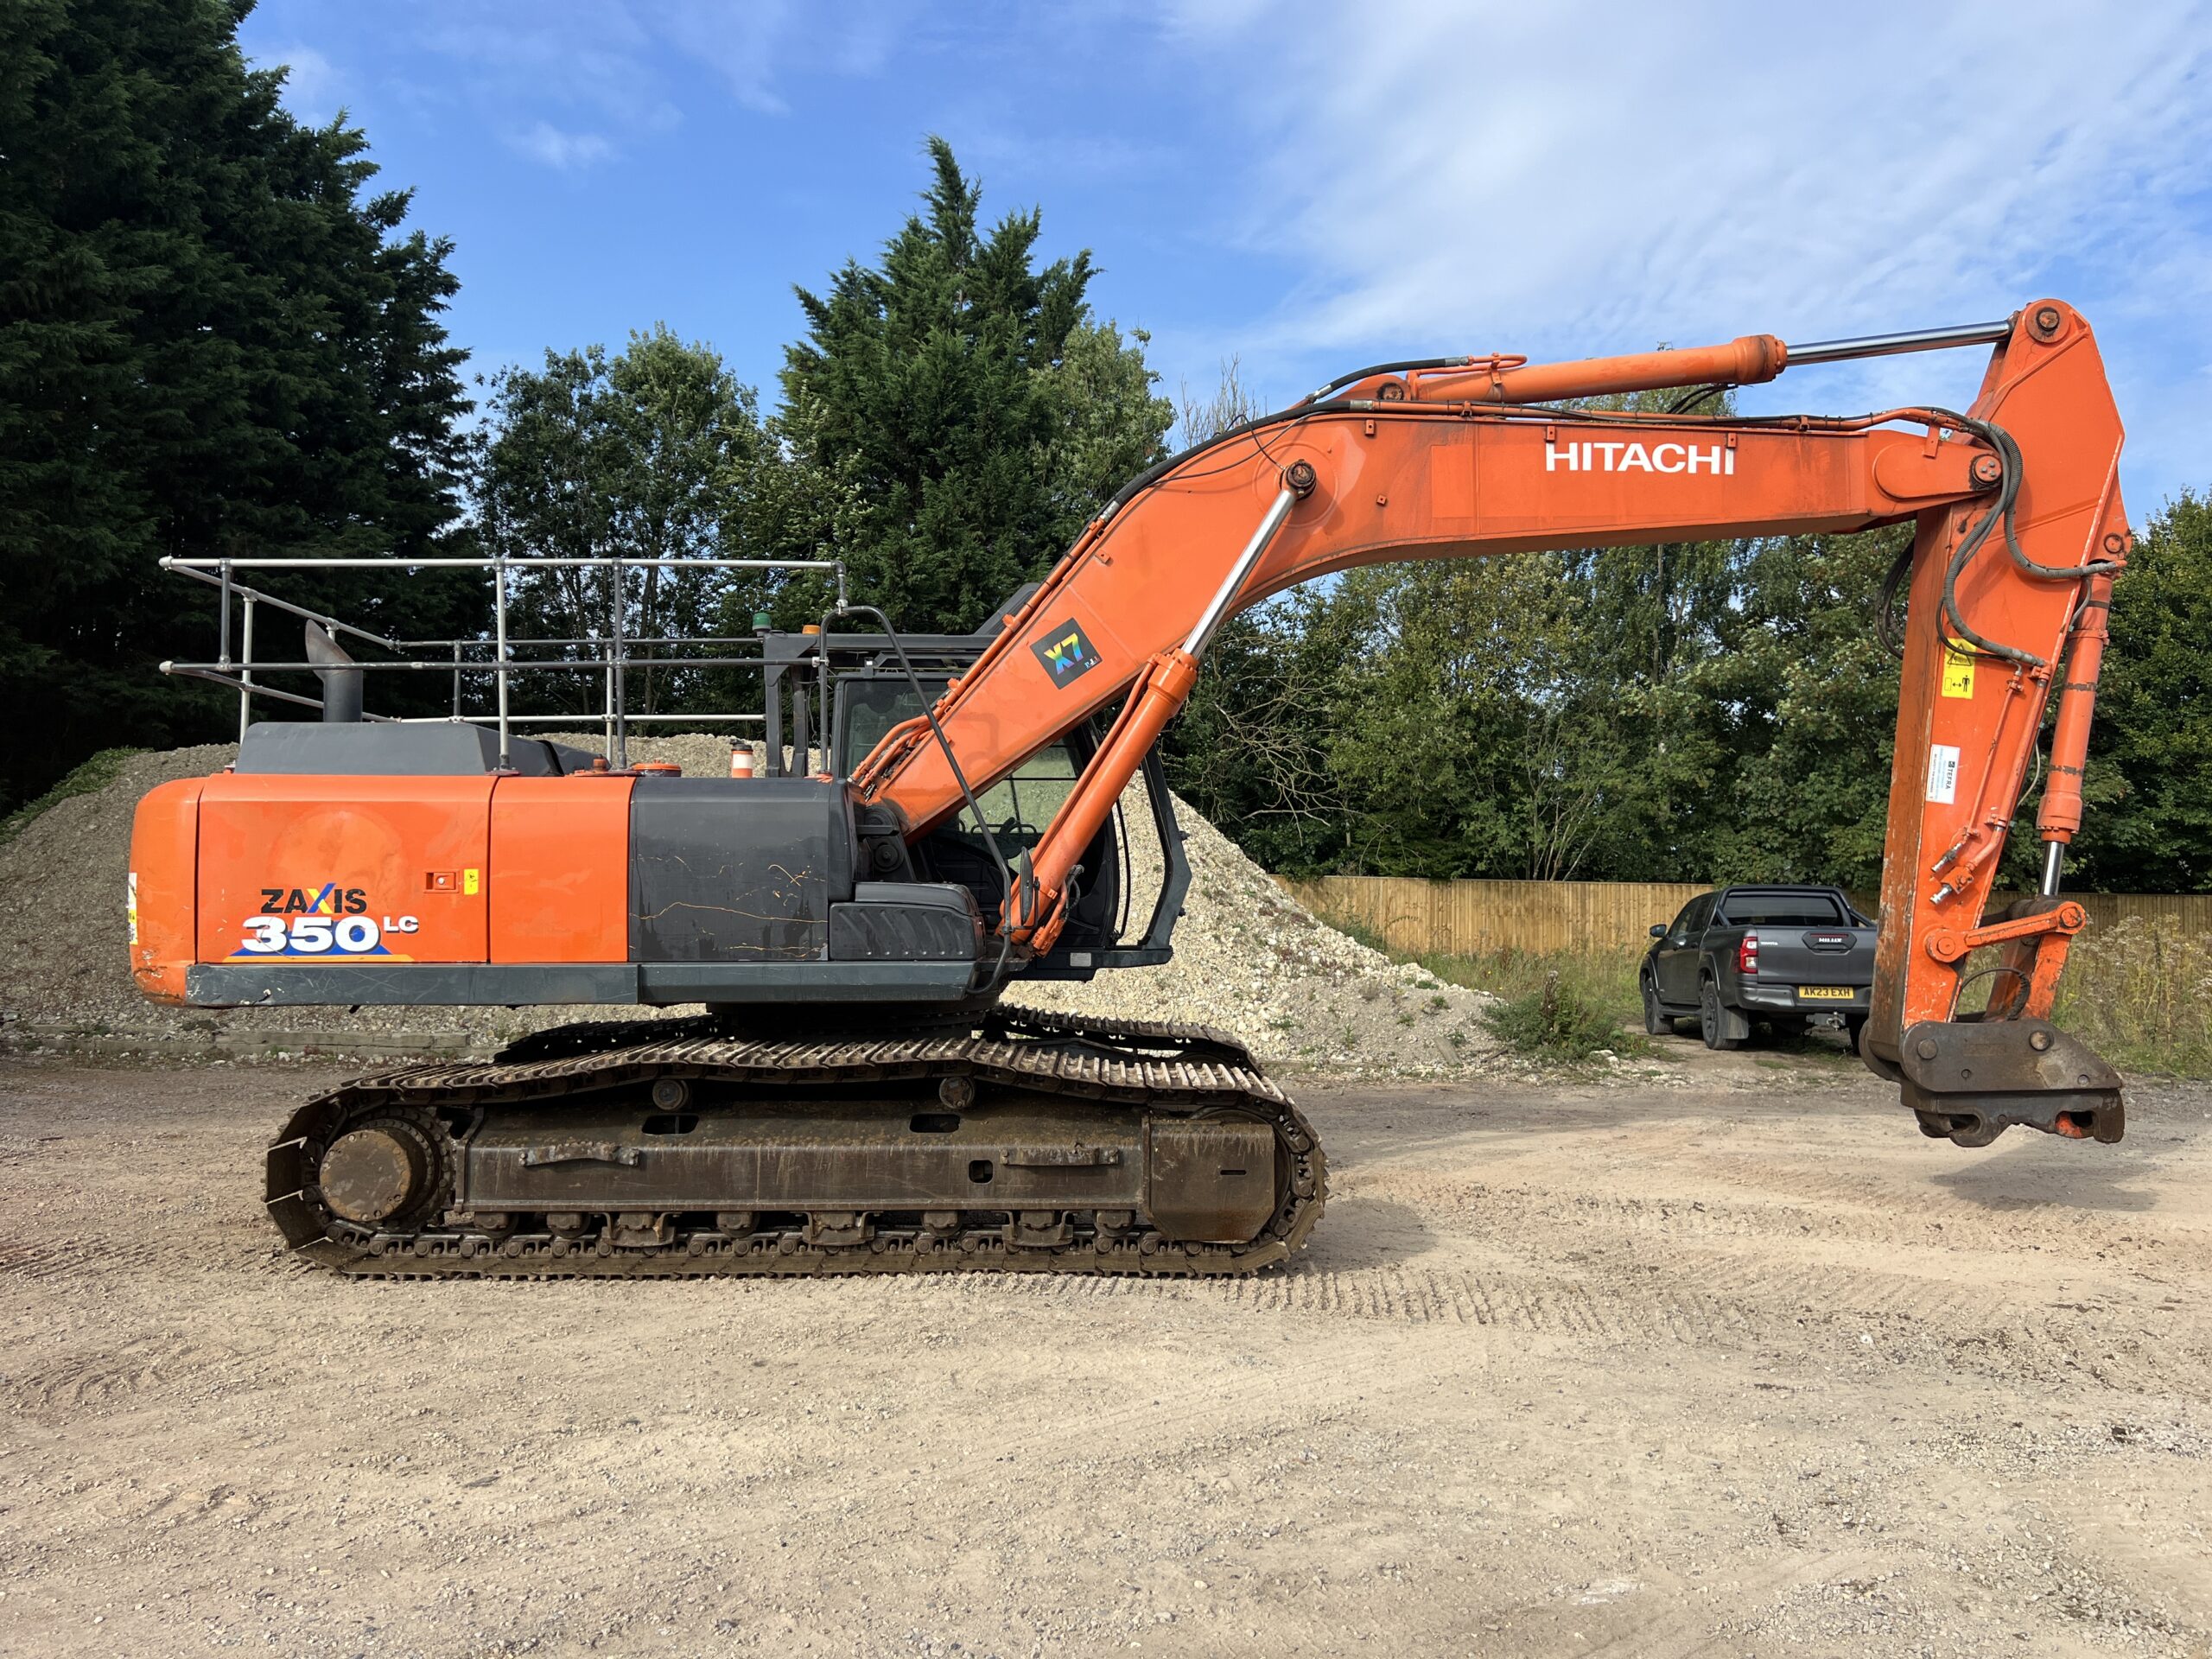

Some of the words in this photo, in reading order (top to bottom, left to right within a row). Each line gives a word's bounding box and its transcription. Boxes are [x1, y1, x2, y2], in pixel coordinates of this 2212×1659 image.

[1545, 442, 1734, 475] HITACHI
[1043, 632, 1084, 675] X7
[1945, 768, 1954, 790] TEFRA
[260, 882, 367, 914] ZAXIS
[241, 916, 381, 953] 350
[383, 916, 419, 933] LC
[1803, 988, 1829, 996] AK23
[1831, 988, 1850, 997] EXH
